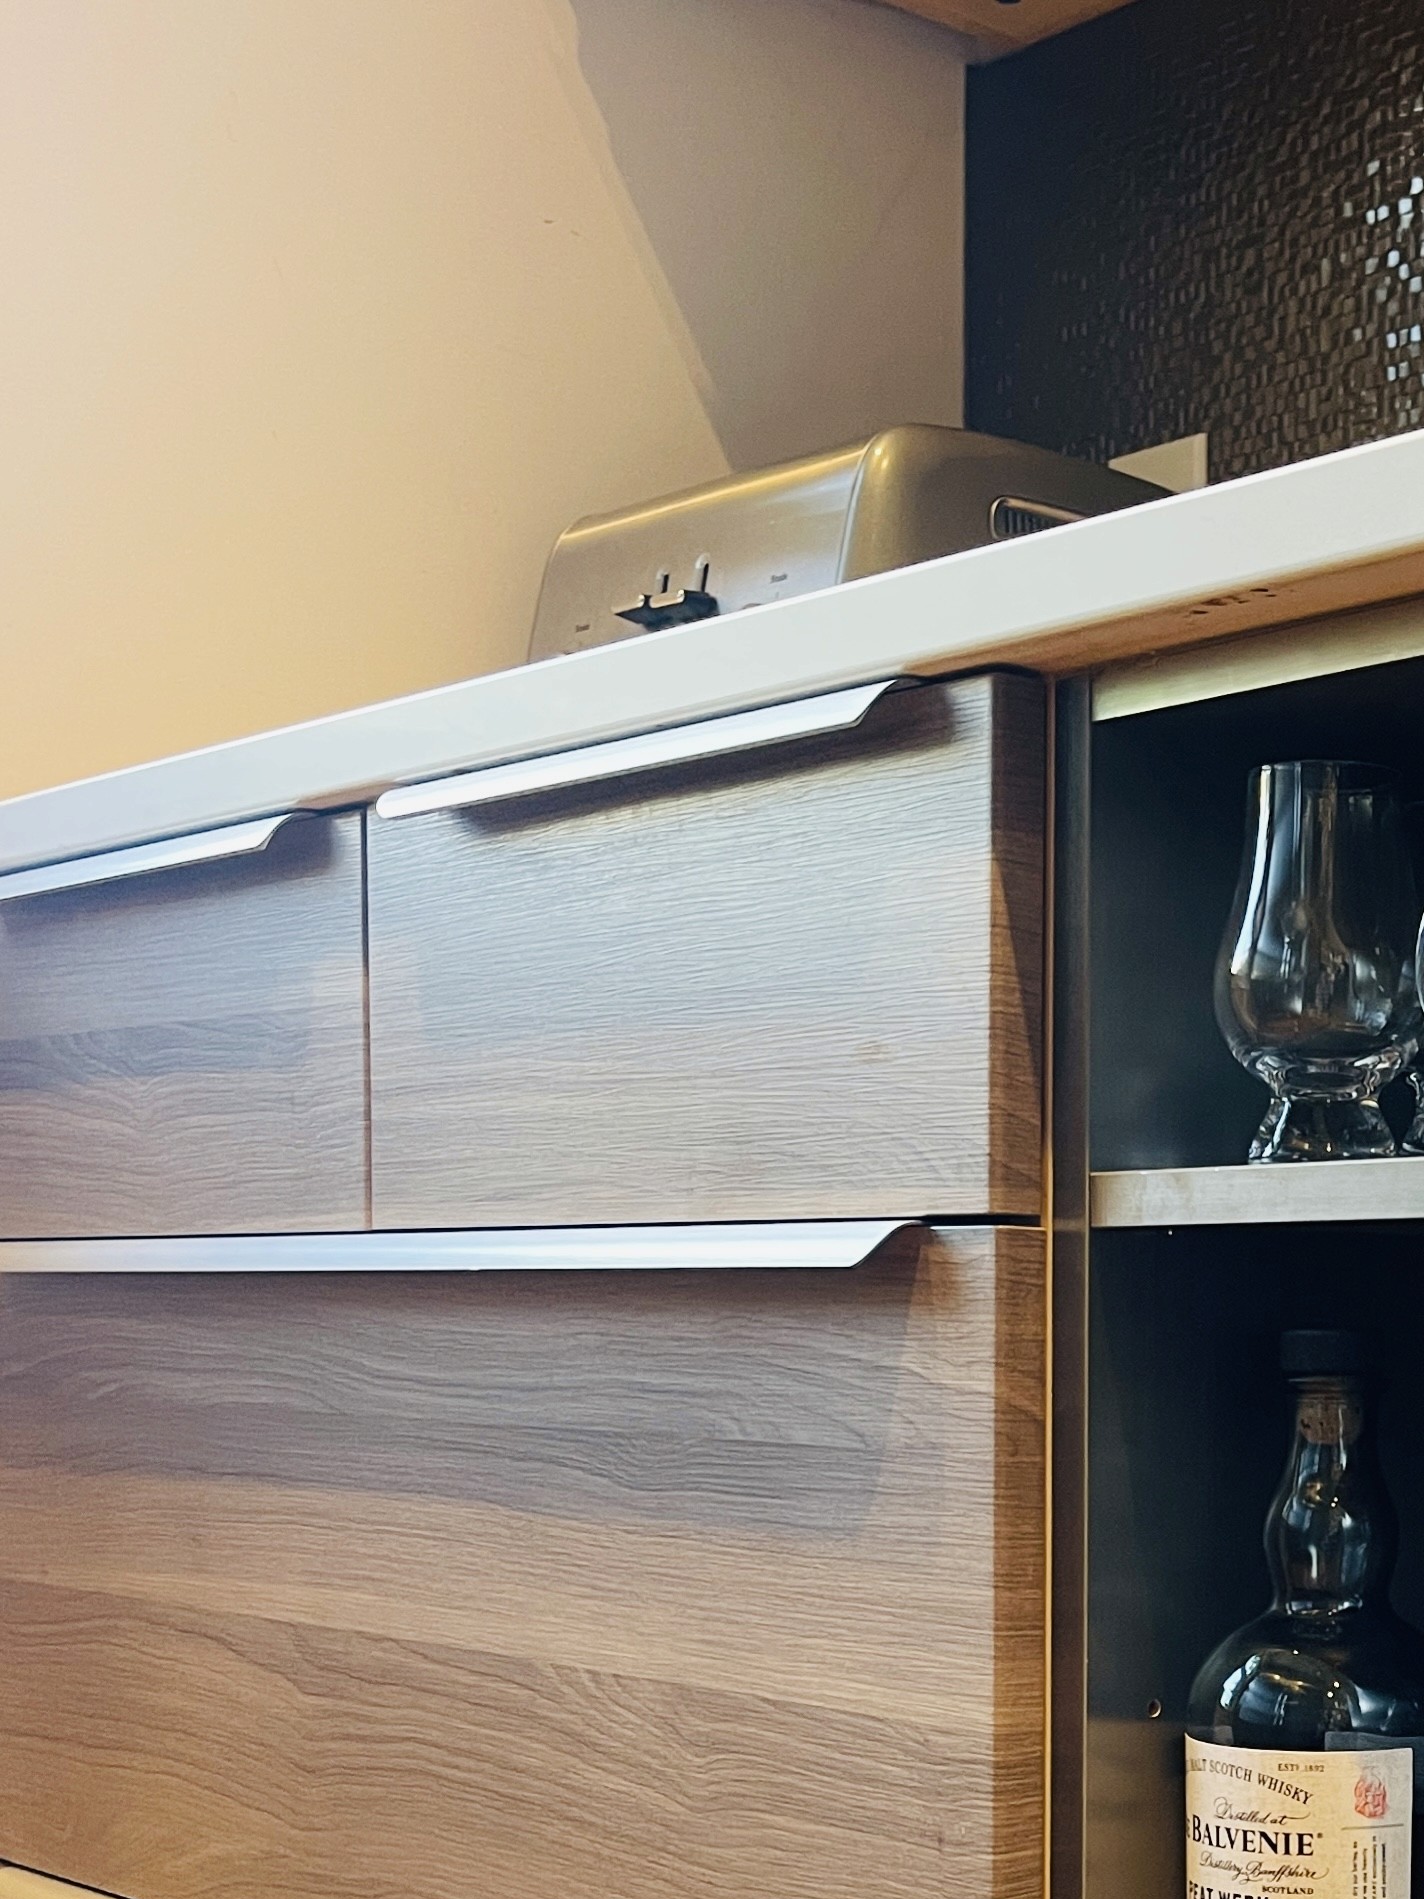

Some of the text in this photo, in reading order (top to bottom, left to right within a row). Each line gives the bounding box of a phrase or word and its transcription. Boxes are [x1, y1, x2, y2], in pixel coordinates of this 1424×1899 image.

[1209, 1760, 1253, 1783] SCOTCH
[1257, 1772, 1314, 1805] WHISKY
[1213, 1796, 1271, 1824] Distilled
[1192, 1814, 1314, 1857] BALVENIE
[1262, 1885, 1314, 1895] SCOTLAND
